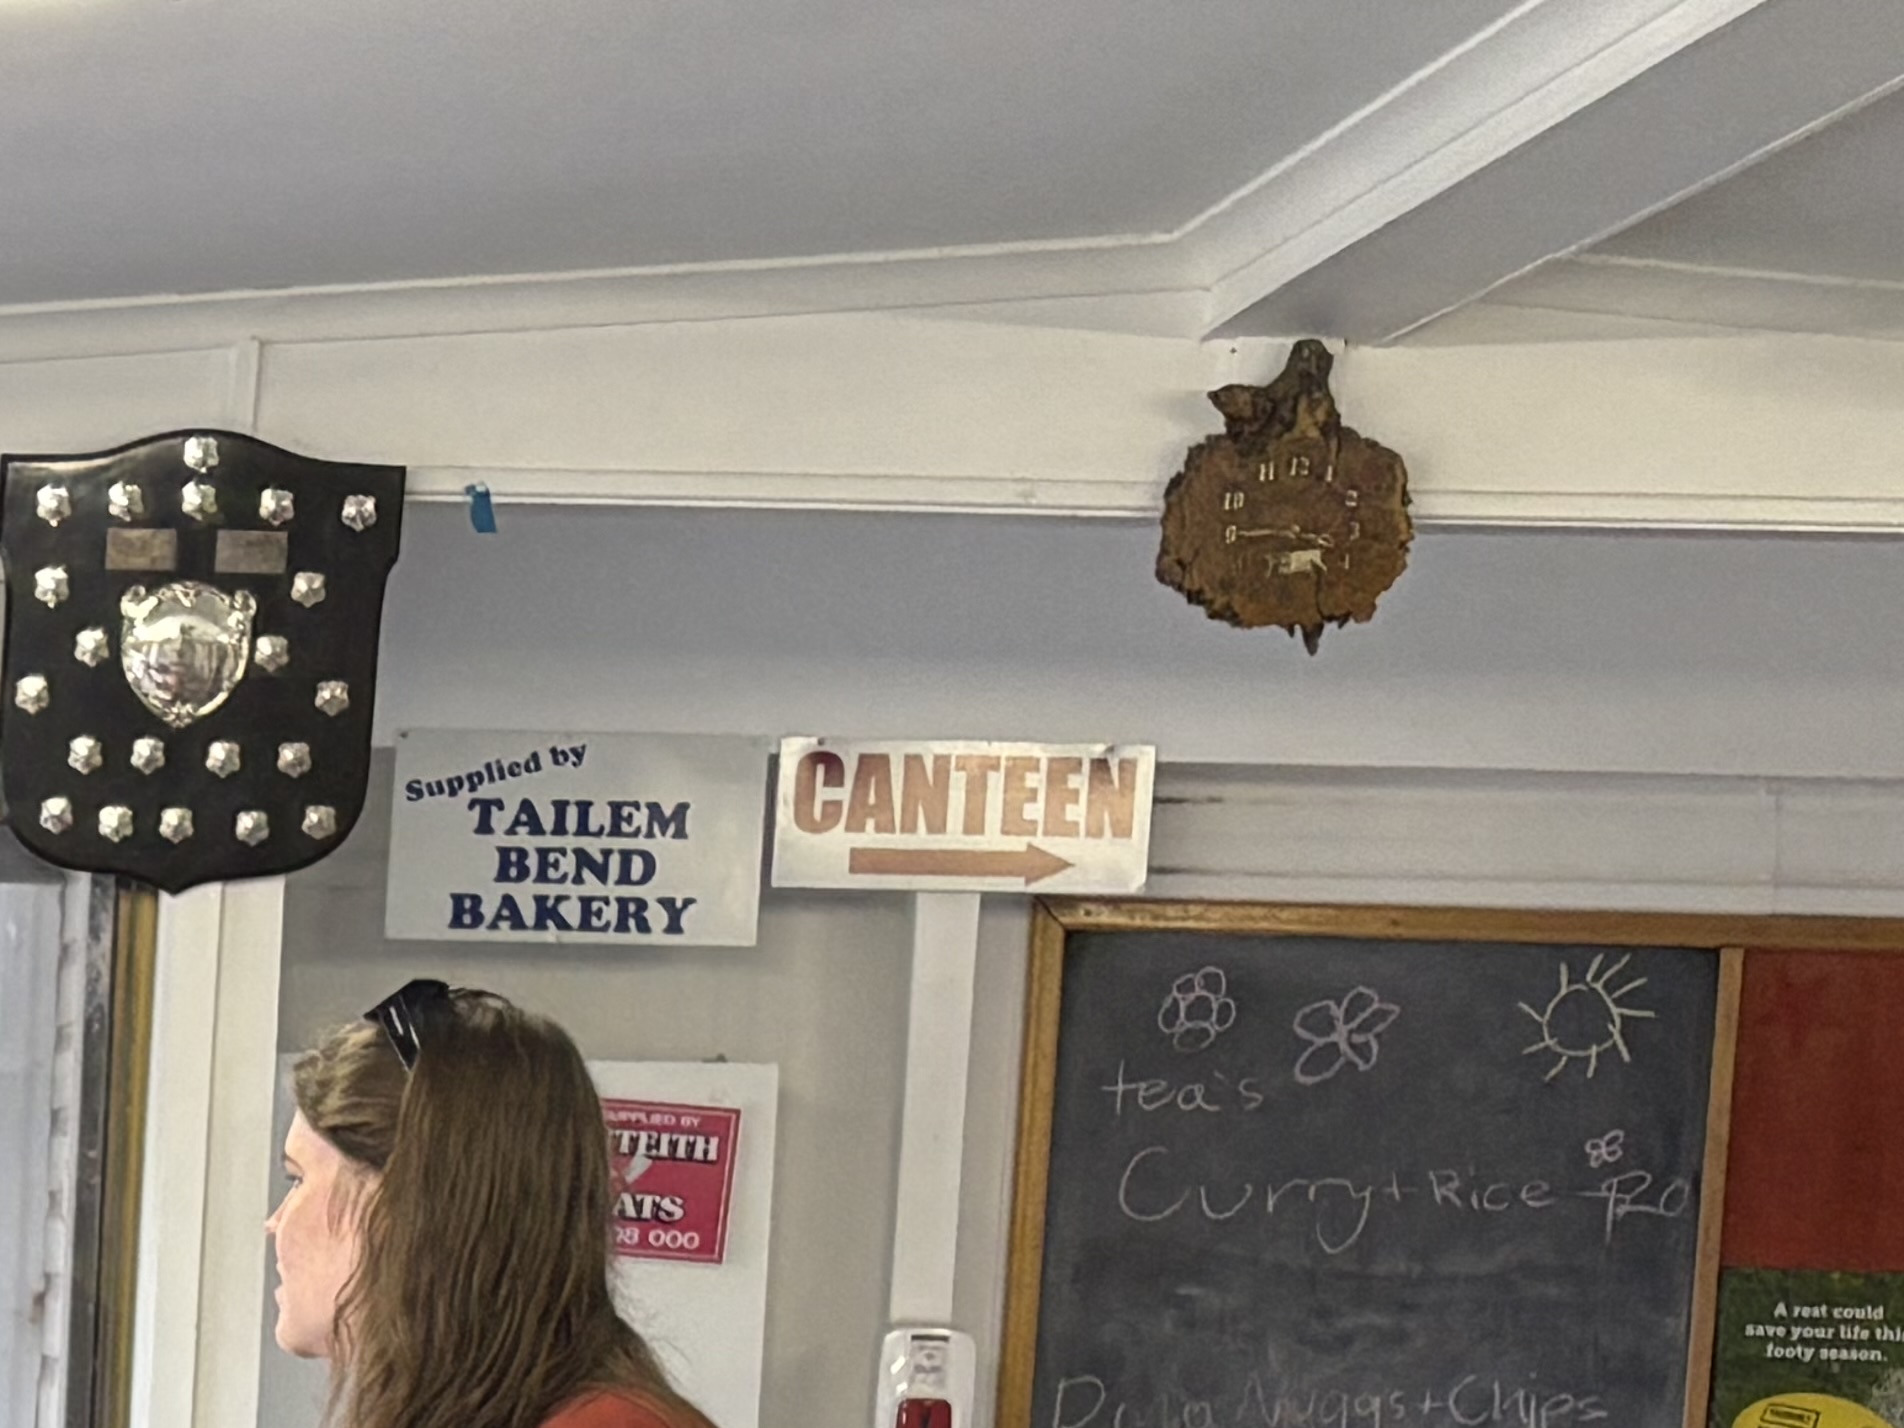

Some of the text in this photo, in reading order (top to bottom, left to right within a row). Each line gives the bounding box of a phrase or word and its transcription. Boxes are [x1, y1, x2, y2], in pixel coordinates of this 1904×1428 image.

[404, 743, 587, 802] Supplied by
[792, 749, 1139, 840] CANTEEN
[467, 797, 692, 840] TAILEM
[492, 845, 657, 886] BEND
[447, 892, 698, 935] BAKERY
[680, 1115, 702, 1128] BY
[608, 1129, 720, 1162] TEITH
[612, 1191, 685, 1222] ATS
[647, 1228, 701, 1250] 000
[1773, 1301, 1884, 1321] A rest could
[1744, 1323, 1787, 1338] save
[1790, 1325, 1835, 1341] your
[1839, 1324, 1871, 1340] life
[1766, 1341, 1888, 1364] footy season.
